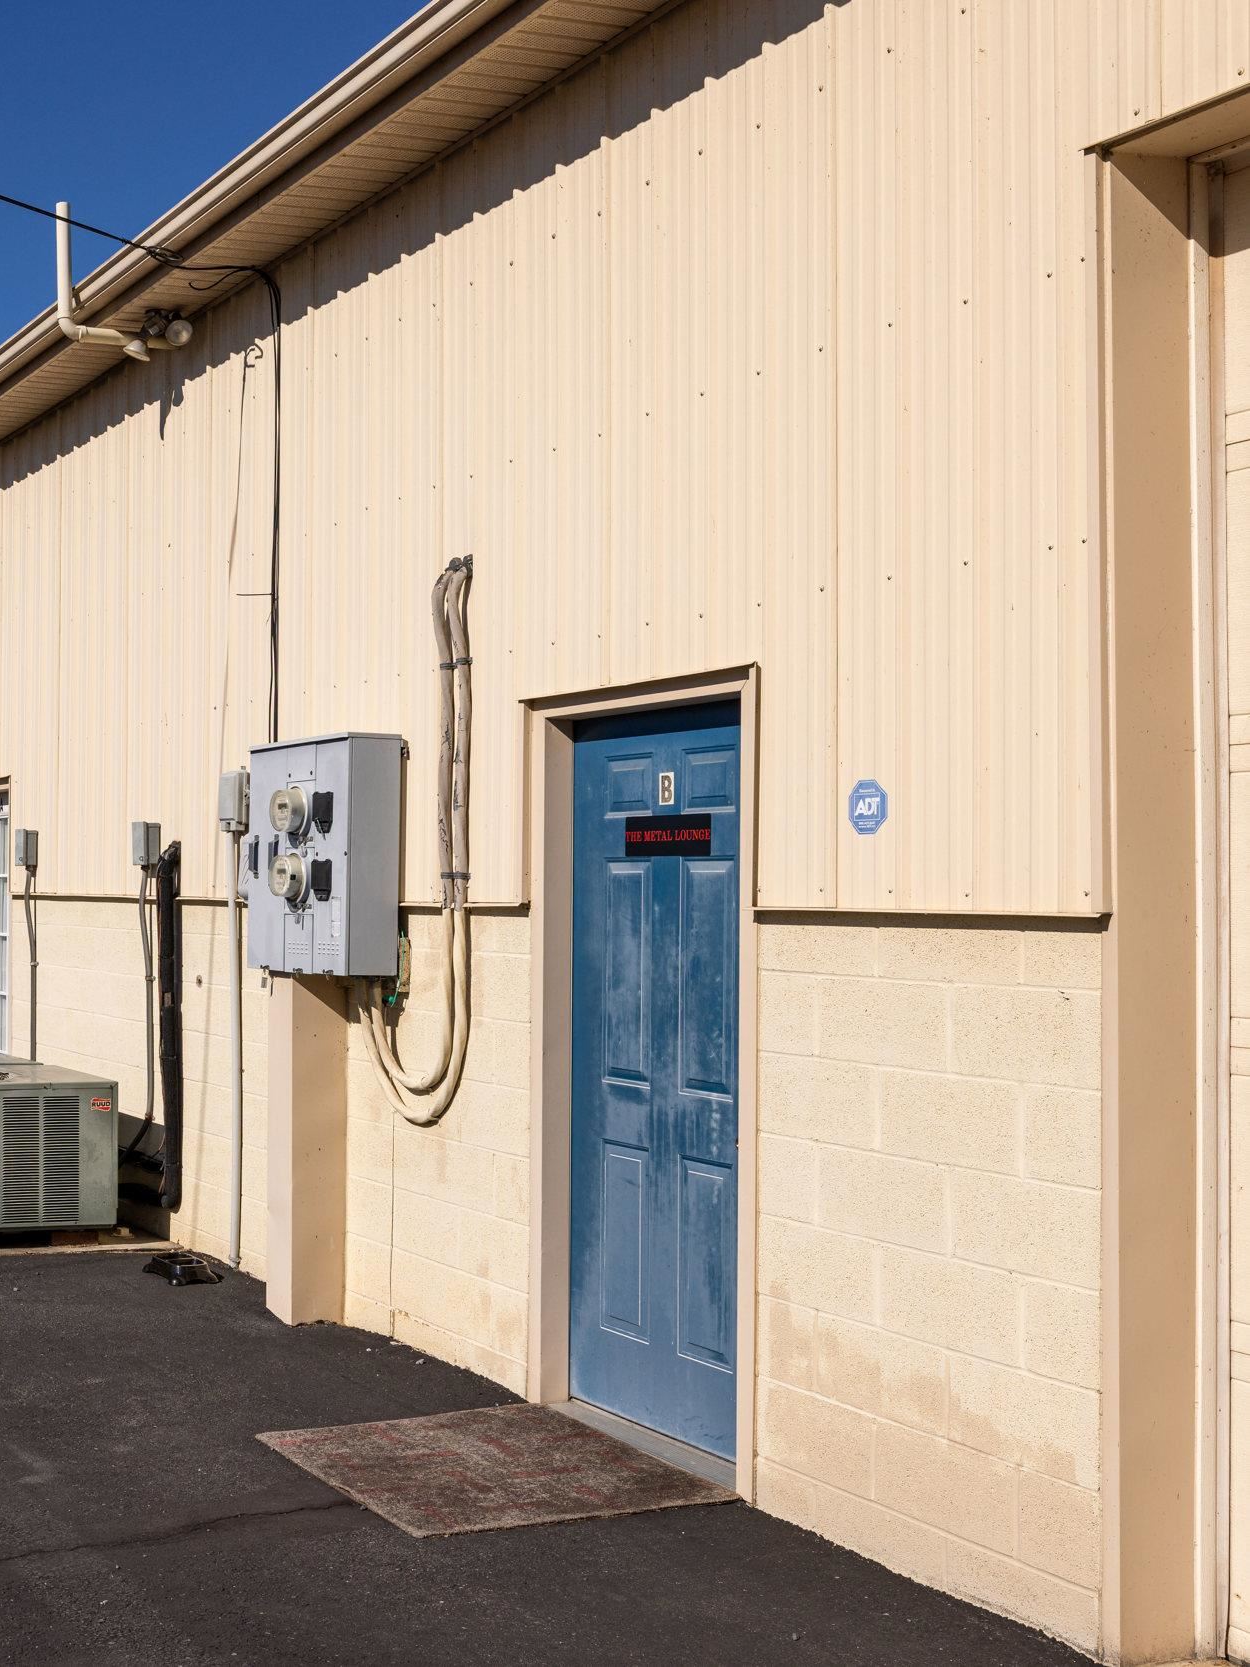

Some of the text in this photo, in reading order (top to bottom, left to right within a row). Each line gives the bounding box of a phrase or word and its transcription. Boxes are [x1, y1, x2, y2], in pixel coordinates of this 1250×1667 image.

[661, 775, 672, 803] B
[854, 797, 880, 815] ADT
[626, 829, 710, 841] THE METAL LOUNGE
